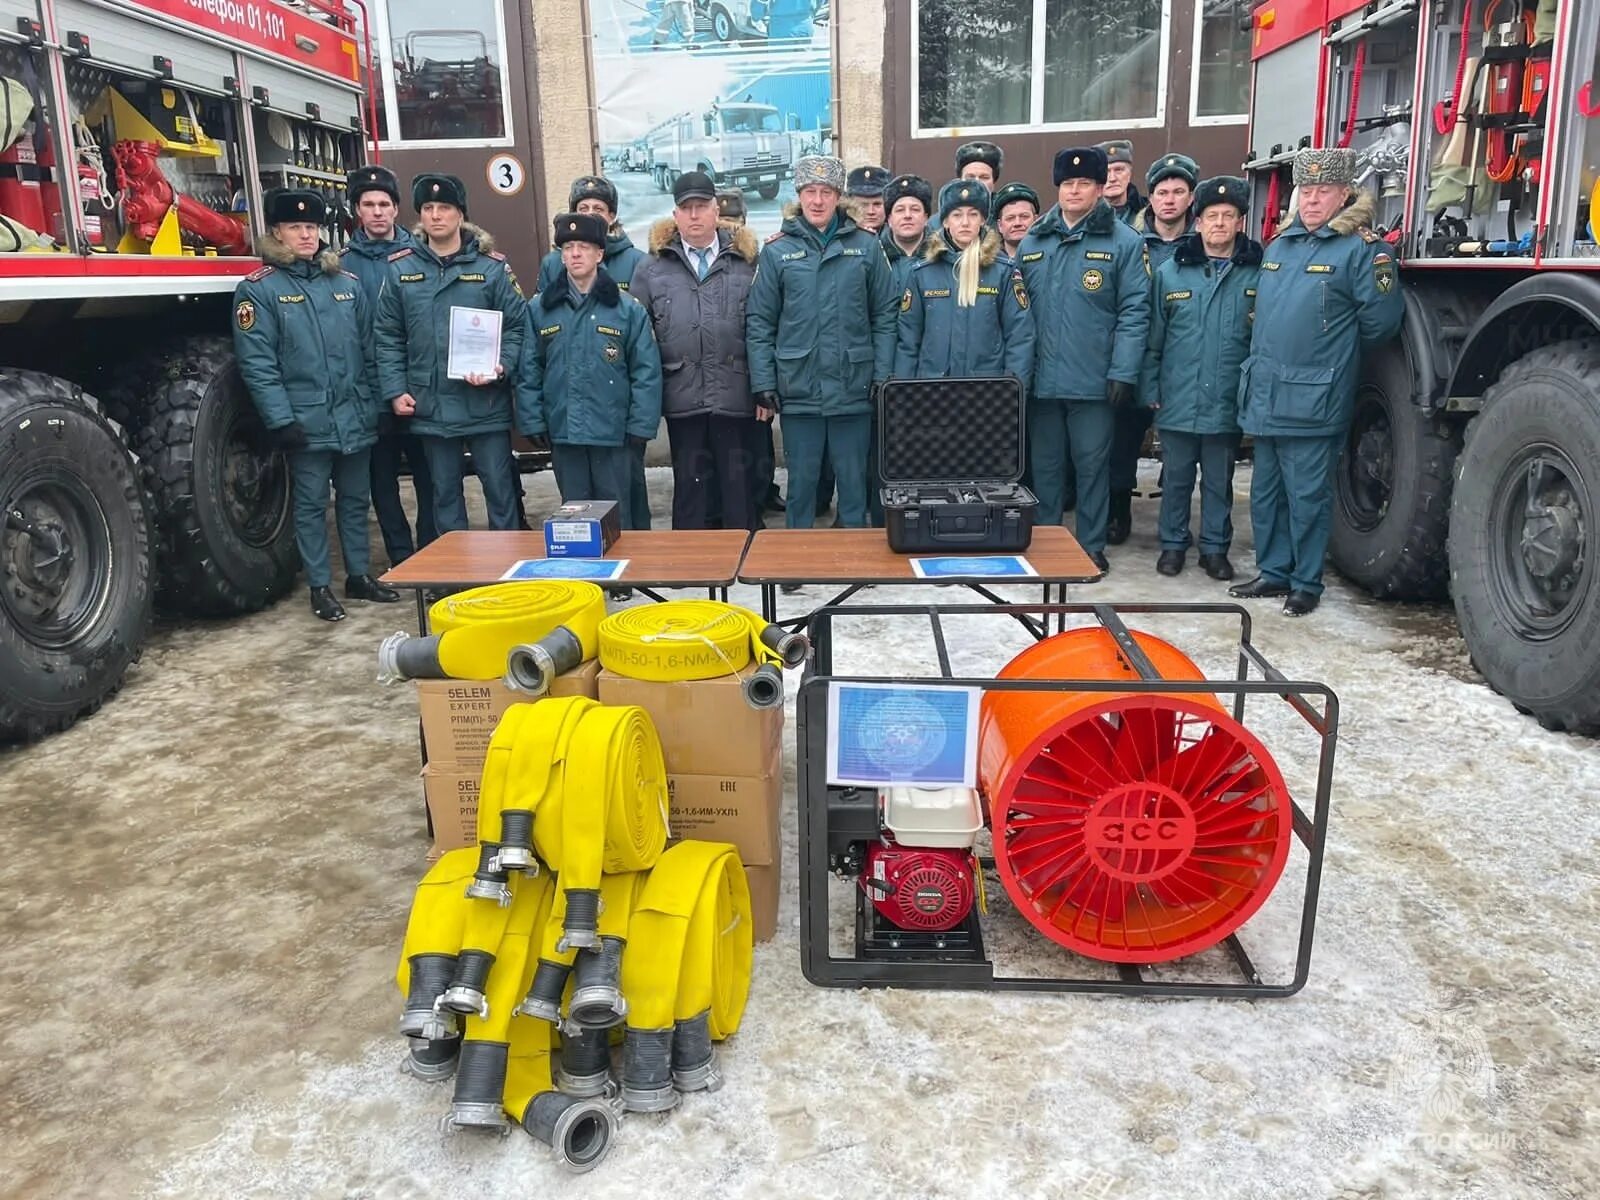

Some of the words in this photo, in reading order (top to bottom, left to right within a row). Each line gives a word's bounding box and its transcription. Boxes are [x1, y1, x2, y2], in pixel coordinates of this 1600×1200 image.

[247, 3, 286, 40] 01,101
[498, 164, 513, 188] 3
[448, 687, 491, 699] 5ELEM
[450, 702, 491, 711] EXPERT
